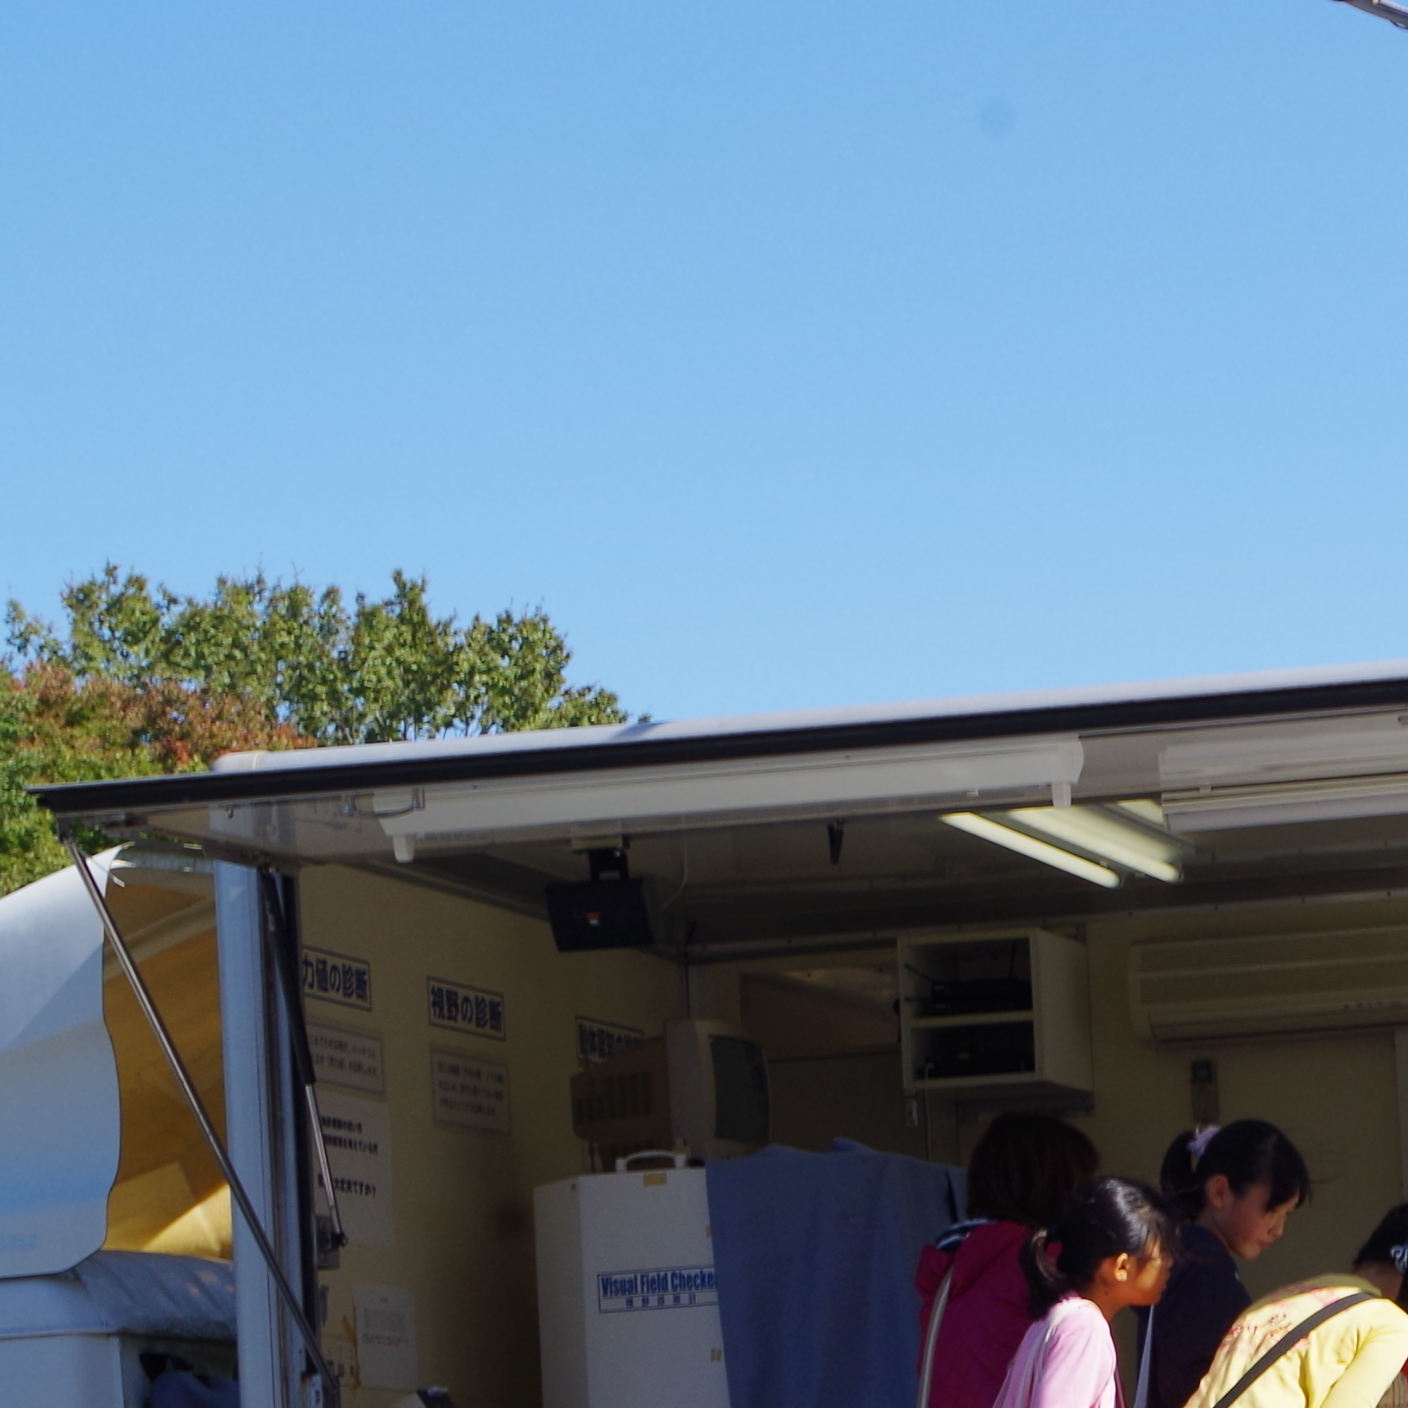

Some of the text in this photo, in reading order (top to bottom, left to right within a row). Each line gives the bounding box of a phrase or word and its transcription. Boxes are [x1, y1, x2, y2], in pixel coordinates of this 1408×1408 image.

[430, 984, 501, 1033] 視野の診断
[600, 1273, 638, 1298] Visual
[640, 1271, 669, 1295] Field
